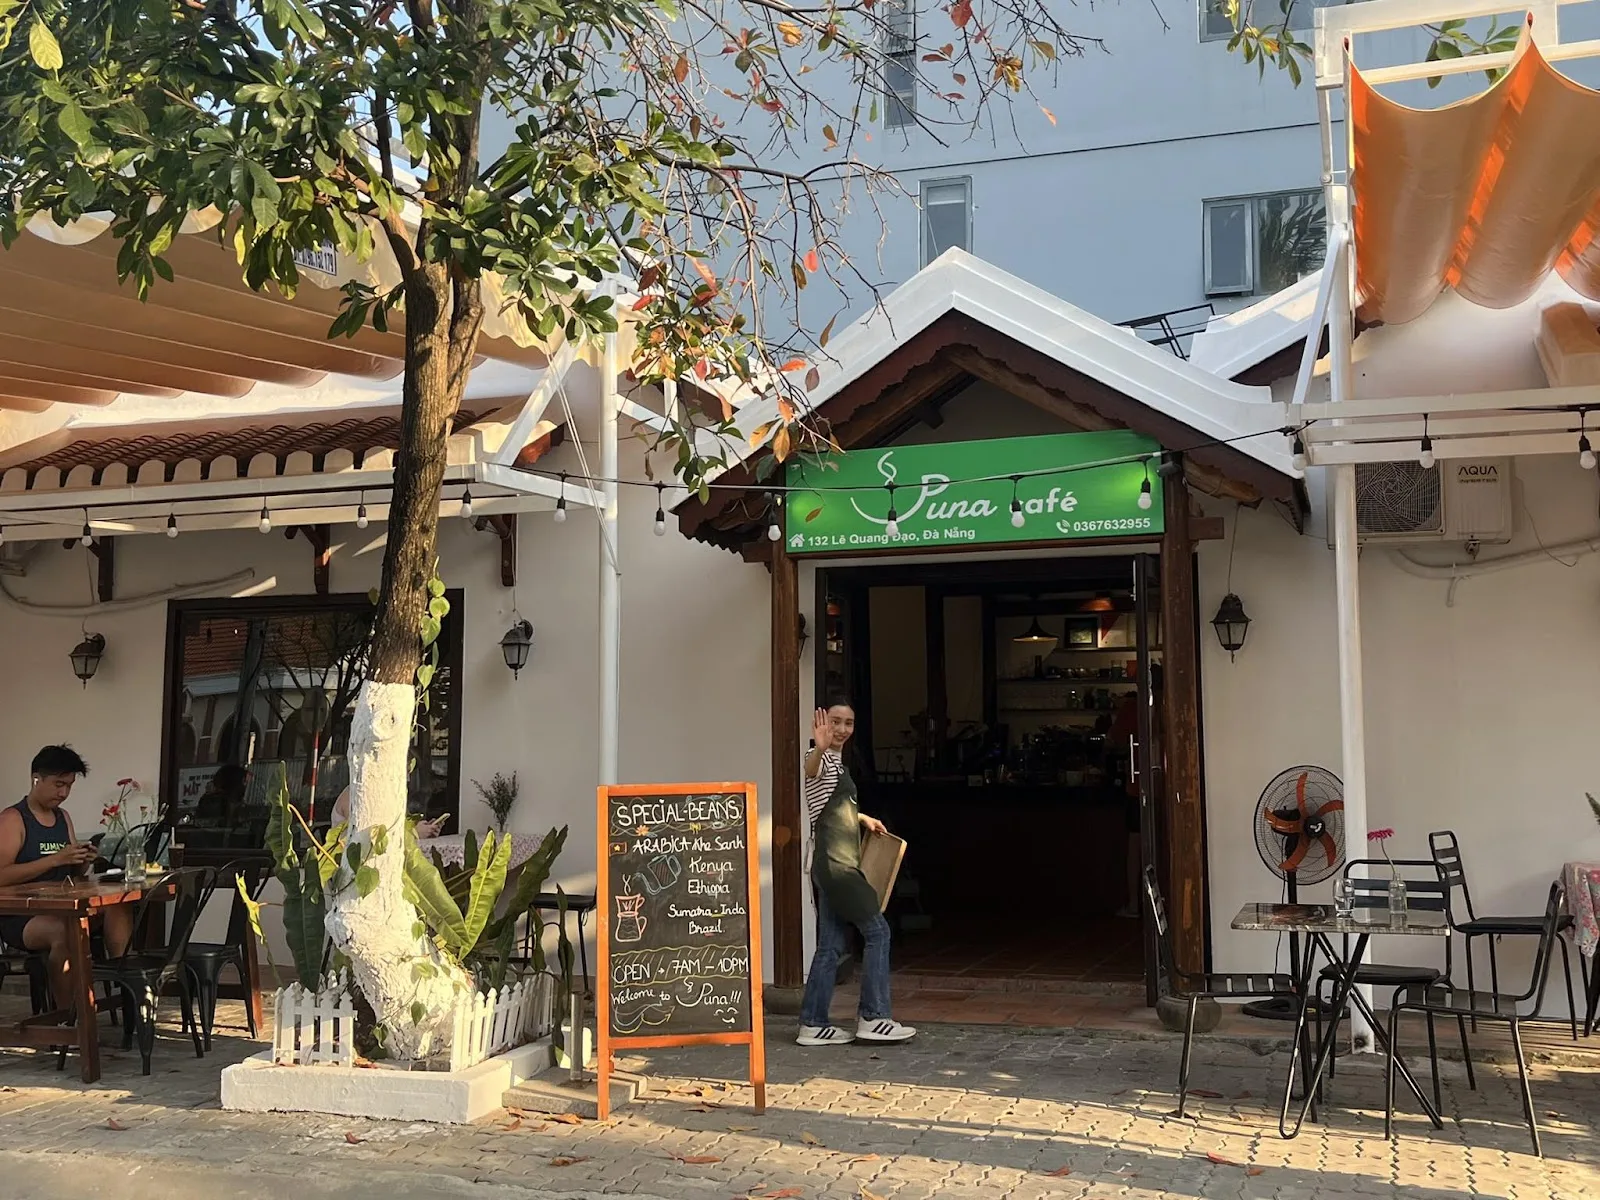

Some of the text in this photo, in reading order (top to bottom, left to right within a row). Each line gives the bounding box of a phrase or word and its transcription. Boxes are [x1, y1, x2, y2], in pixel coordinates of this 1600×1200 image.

[1458, 465, 1498, 476] AQUA
[896, 474, 998, 522] Puna
[1073, 517, 1151, 532] 0367632955
[807, 536, 829, 547] 132
[832, 535, 846, 545] Lê
[849, 534, 889, 545] Quang
[923, 529, 940, 540] Đà
[39, 842, 61, 851] PUMA
[715, 834, 745, 851] Sanh
[688, 879, 730, 899] Ethiopia
[667, 903, 712, 918] Sumatra
[613, 962, 651, 984] OPEN
[671, 958, 701, 975] 7AM
[718, 957, 749, 973] 10PM
[611, 987, 656, 1005] Welcome
[660, 990, 671, 1001] to
